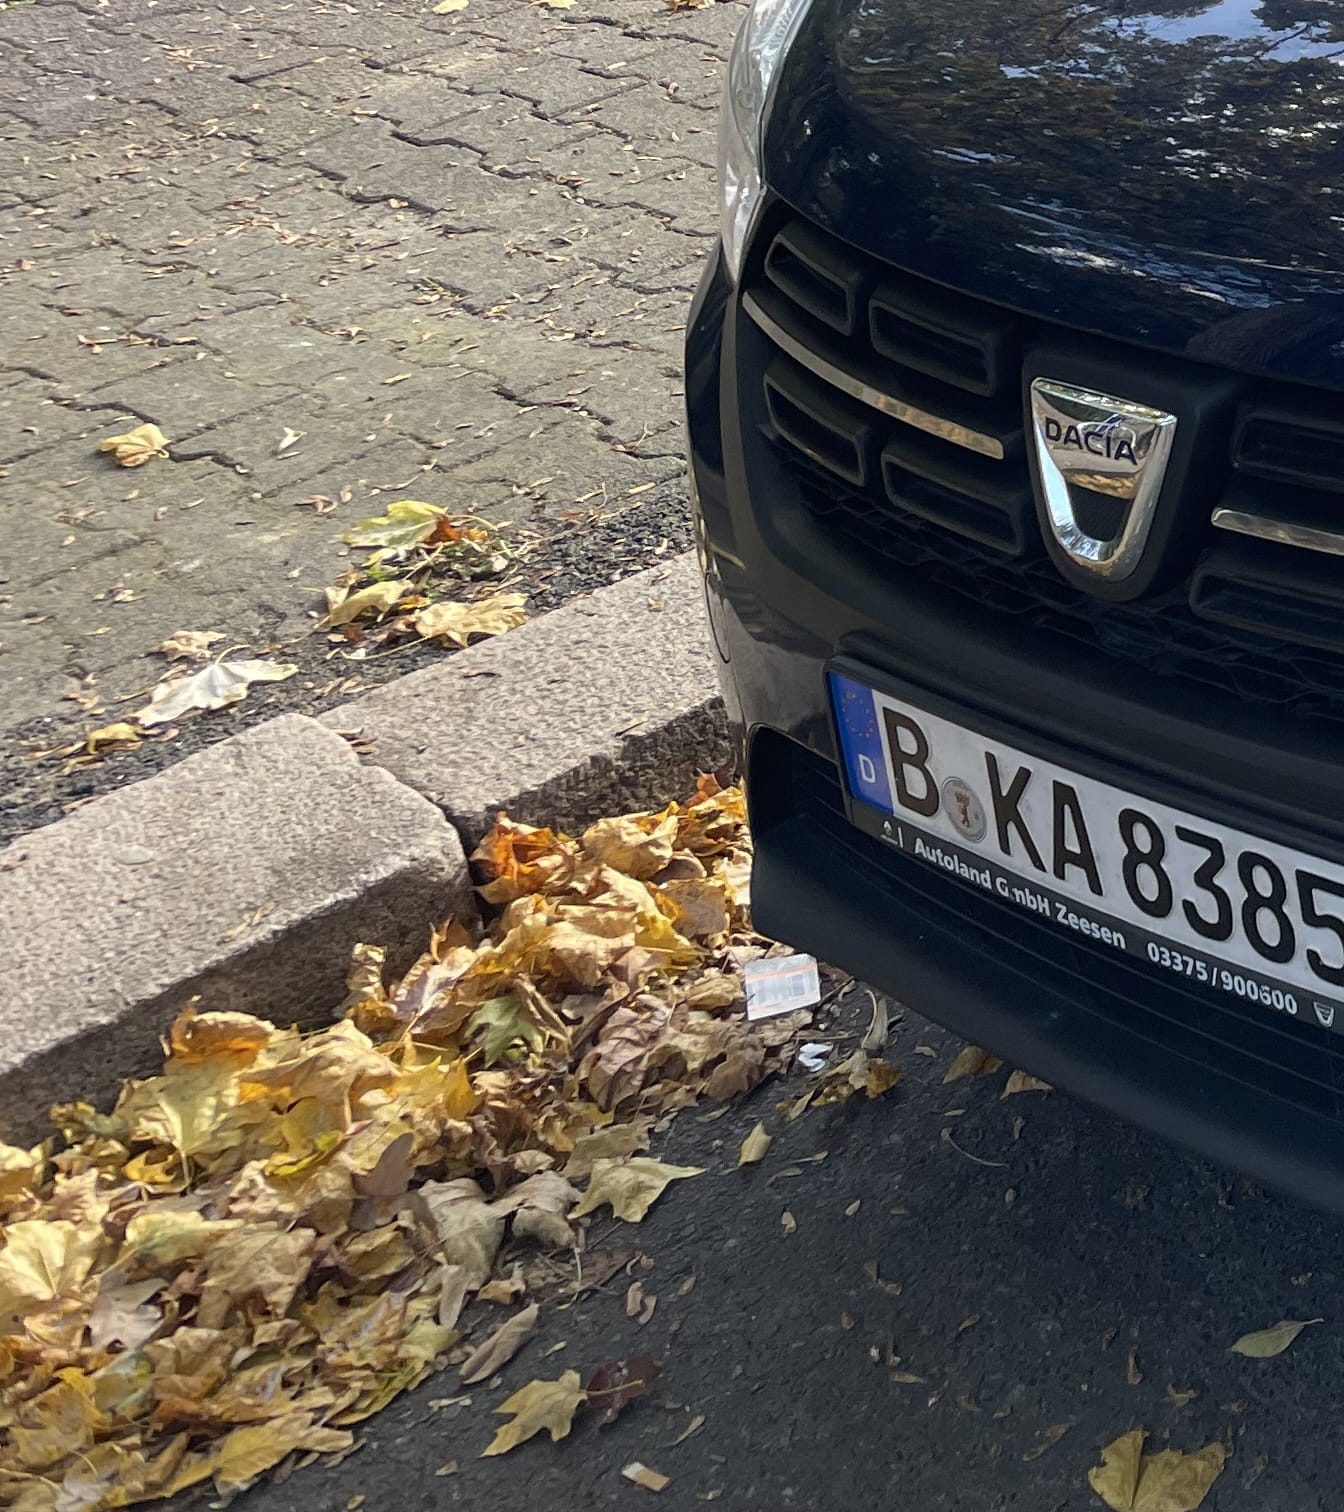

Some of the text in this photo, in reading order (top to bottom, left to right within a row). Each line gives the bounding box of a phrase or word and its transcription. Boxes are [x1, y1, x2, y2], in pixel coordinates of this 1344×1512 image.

[1045, 416, 1138, 466] DACIA
[858, 753, 876, 784] D
[882, 705, 940, 818] B
[985, 750, 1104, 897] KA
[914, 838, 993, 890] Autoland
[1055, 902, 1127, 950] Zeesen
